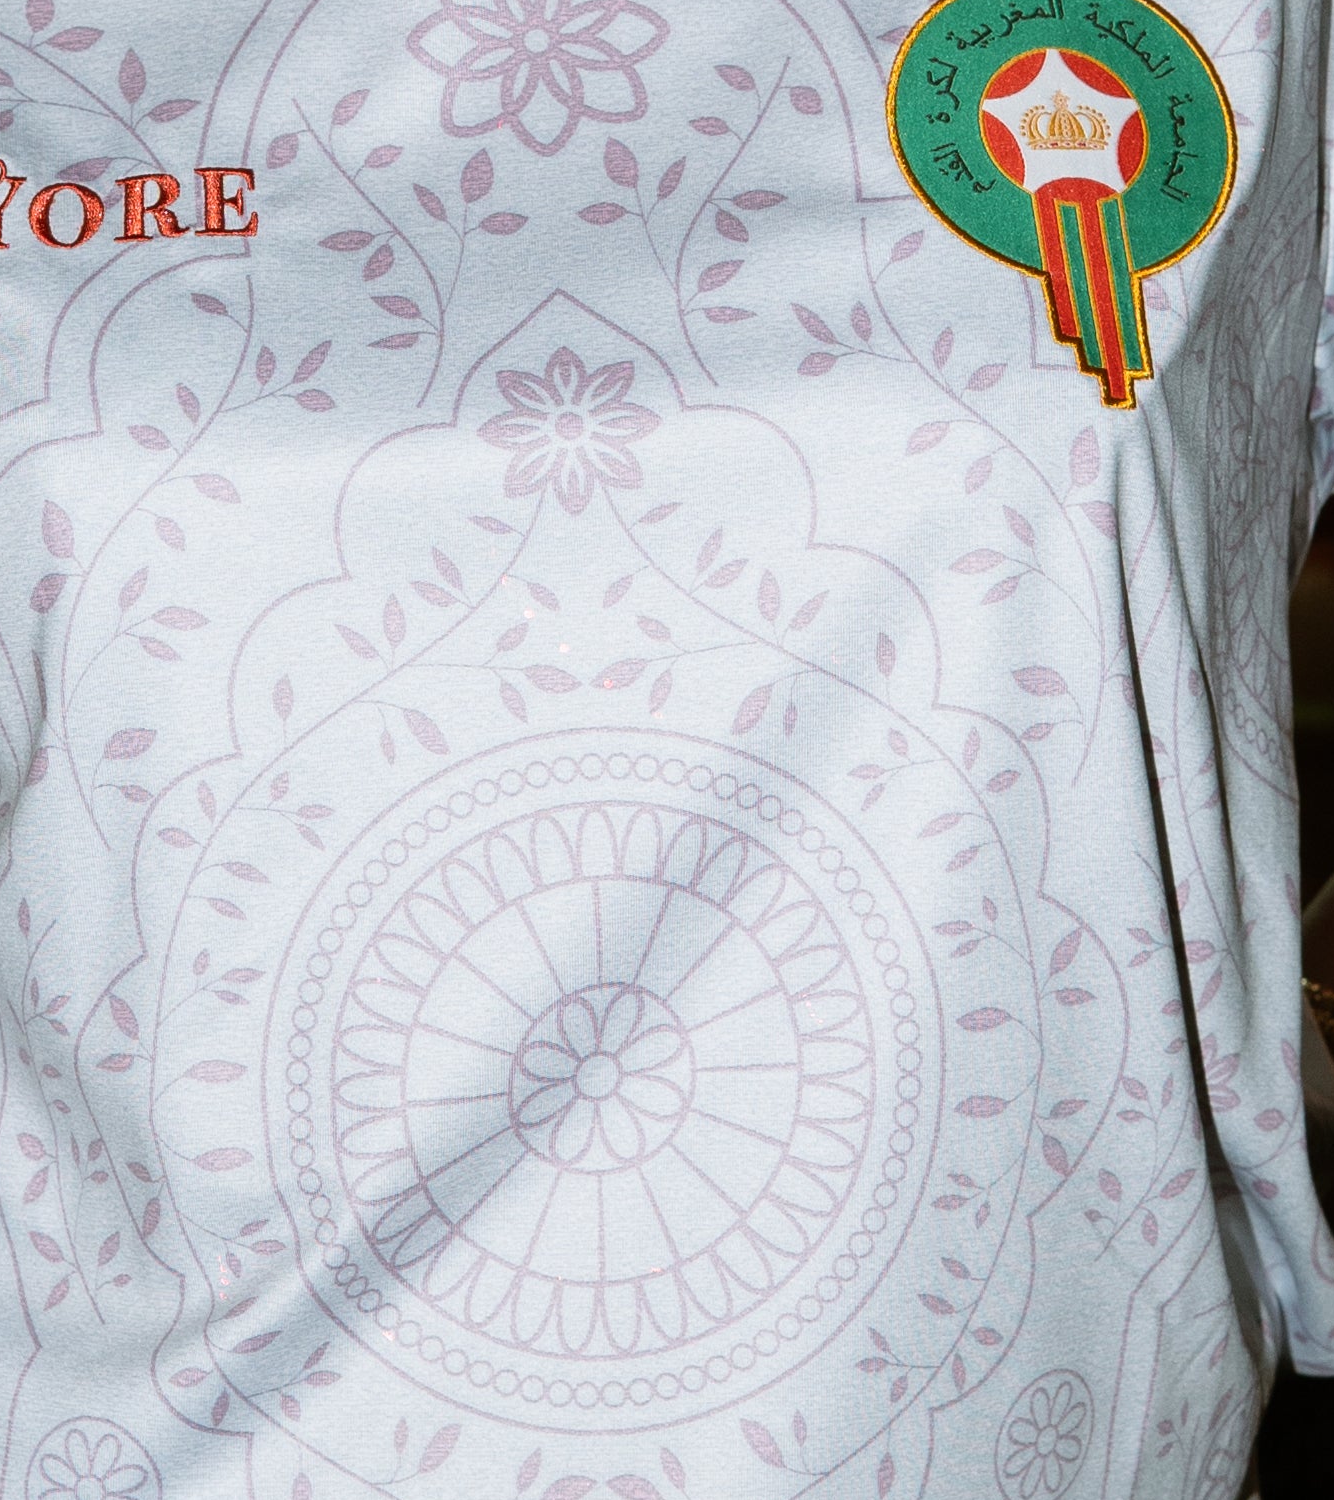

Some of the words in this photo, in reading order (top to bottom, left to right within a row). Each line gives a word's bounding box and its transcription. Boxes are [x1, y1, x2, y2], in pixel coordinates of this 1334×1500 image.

[1083, 1, 1176, 80] الملكية
[925, 56, 961, 124] لكرة
[929, 142, 997, 194] القدم
[1159, 92, 1199, 204] الجامعة
